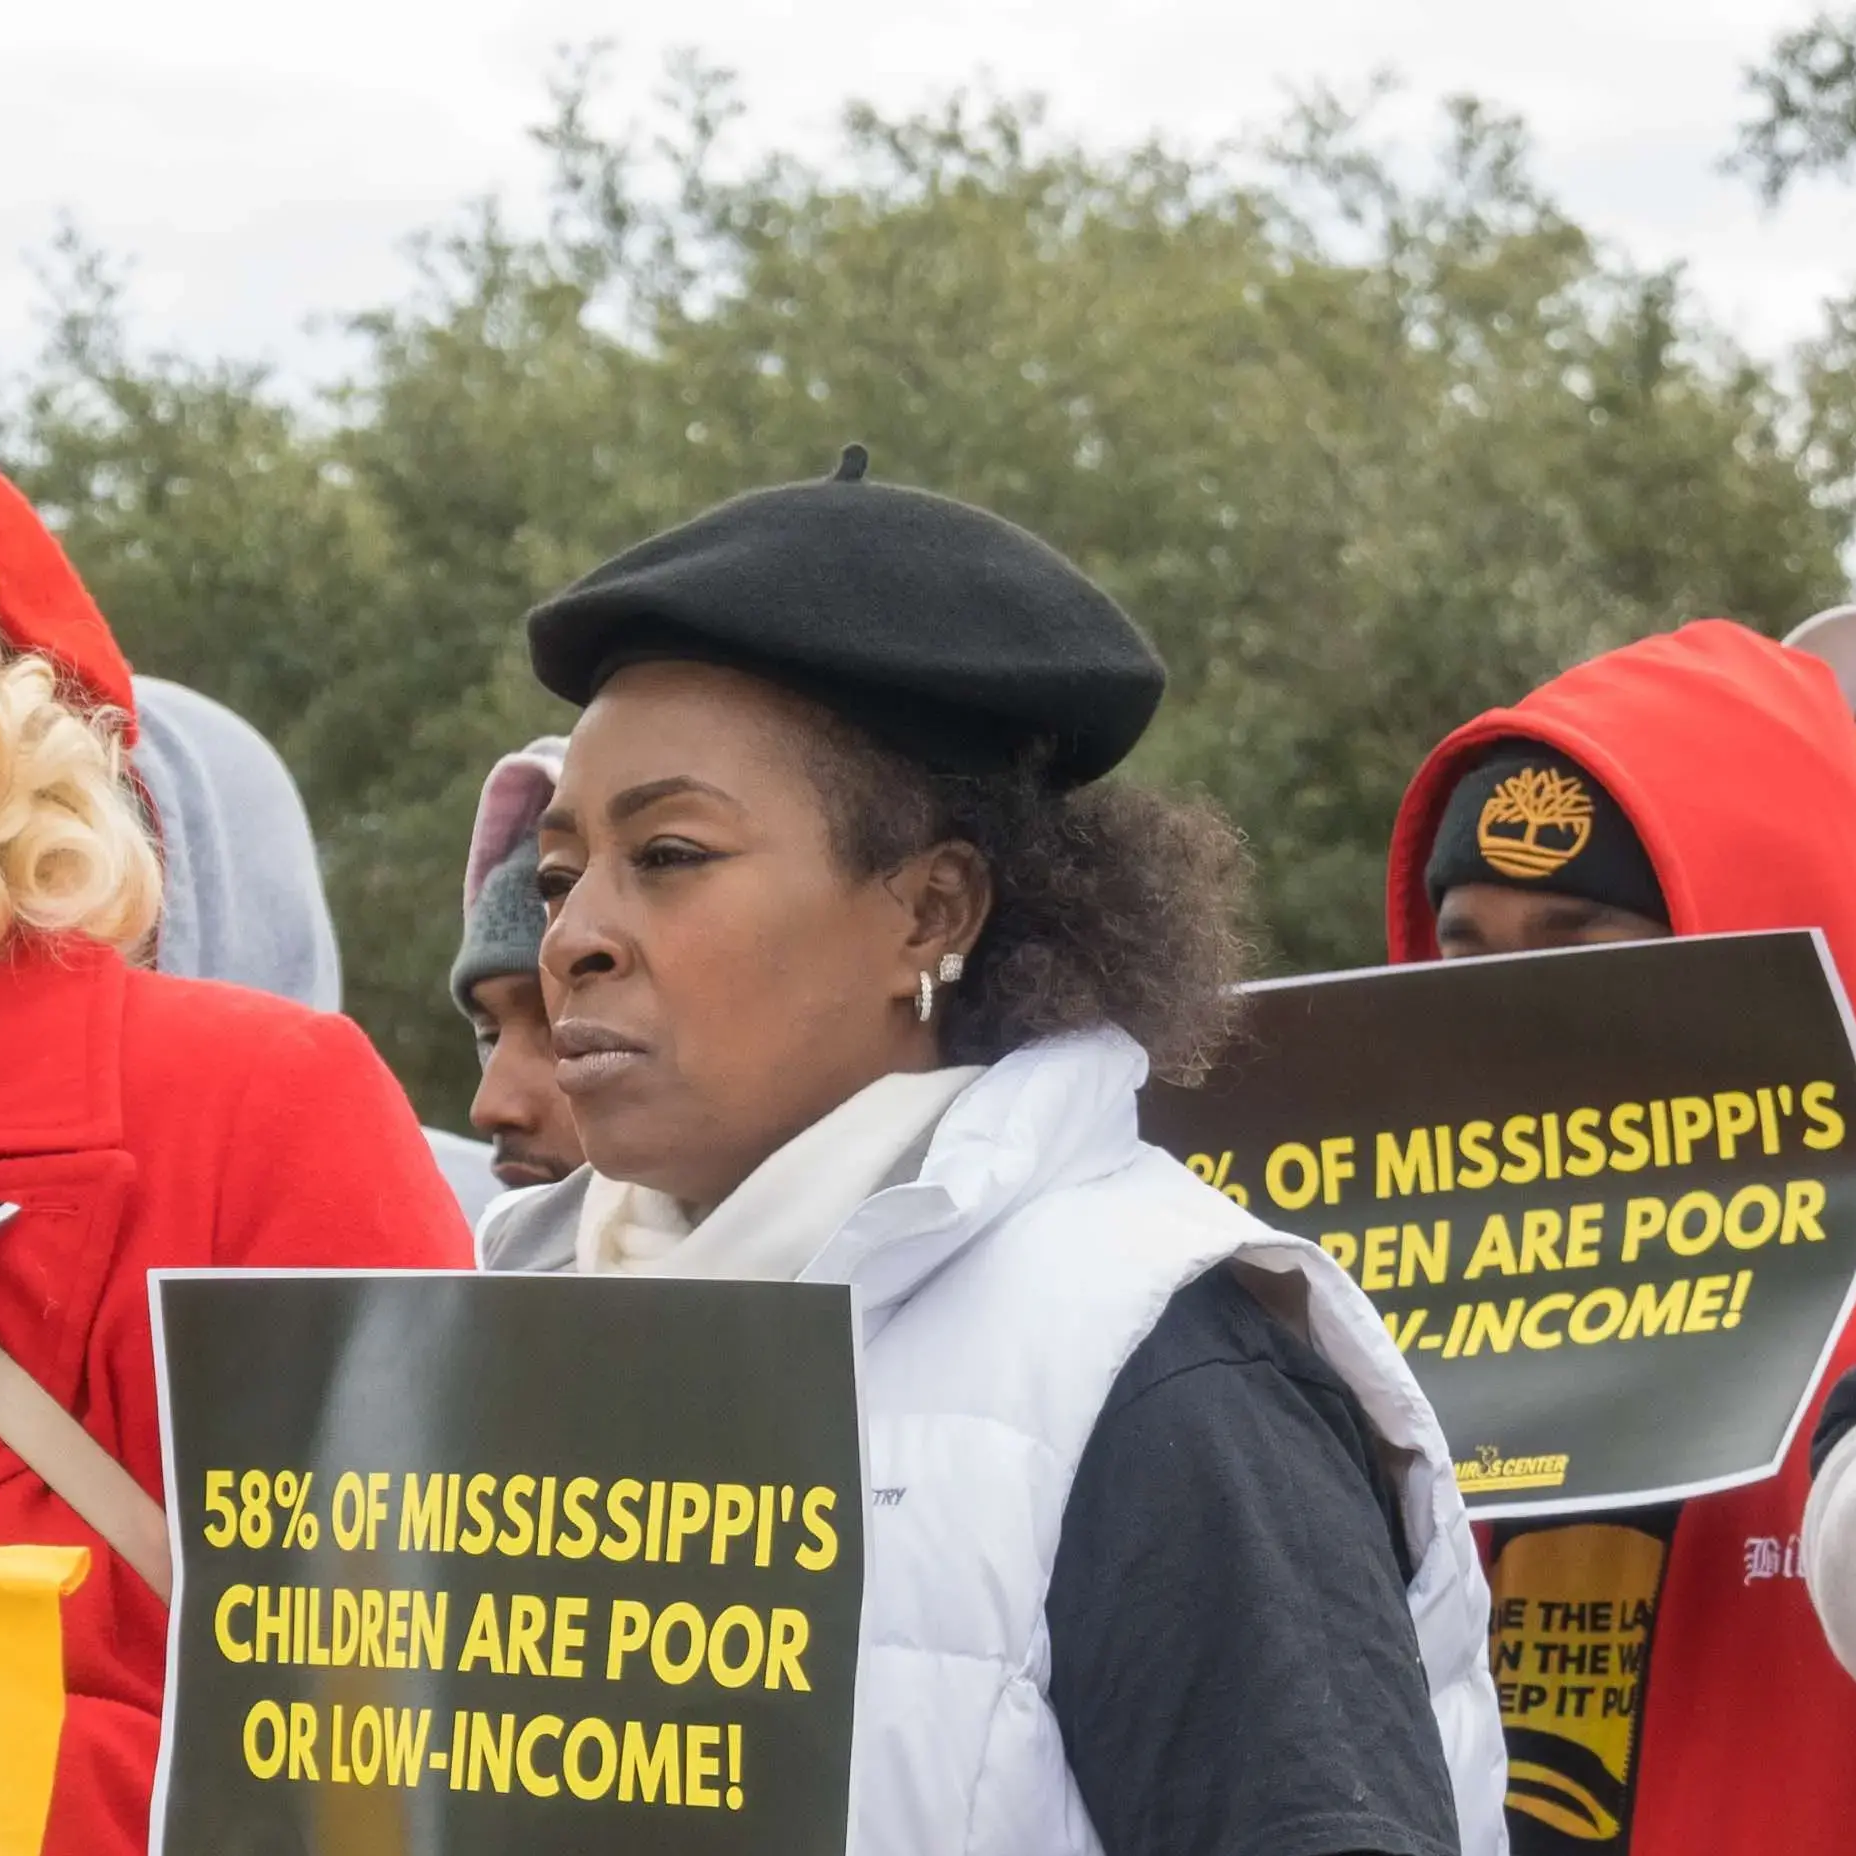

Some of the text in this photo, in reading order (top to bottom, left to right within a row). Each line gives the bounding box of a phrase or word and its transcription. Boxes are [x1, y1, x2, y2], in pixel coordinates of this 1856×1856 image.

[1265, 1137, 1356, 1210] OF
[1376, 1080, 1846, 1200] MISSISSIPPI'S
[1463, 1202, 1604, 1279] ARE
[1621, 1178, 1826, 1262] POOR
[203, 1470, 838, 1571] 58% OF MISSISSIPPI'S
[214, 1583, 812, 1692] CHILDREN ARE POOR
[1534, 1642, 1611, 1675] THE
[1537, 1601, 1613, 1632] THE
[1556, 1685, 1596, 1717] IT
[243, 1700, 744, 1811] OR LOW-INCOME!
